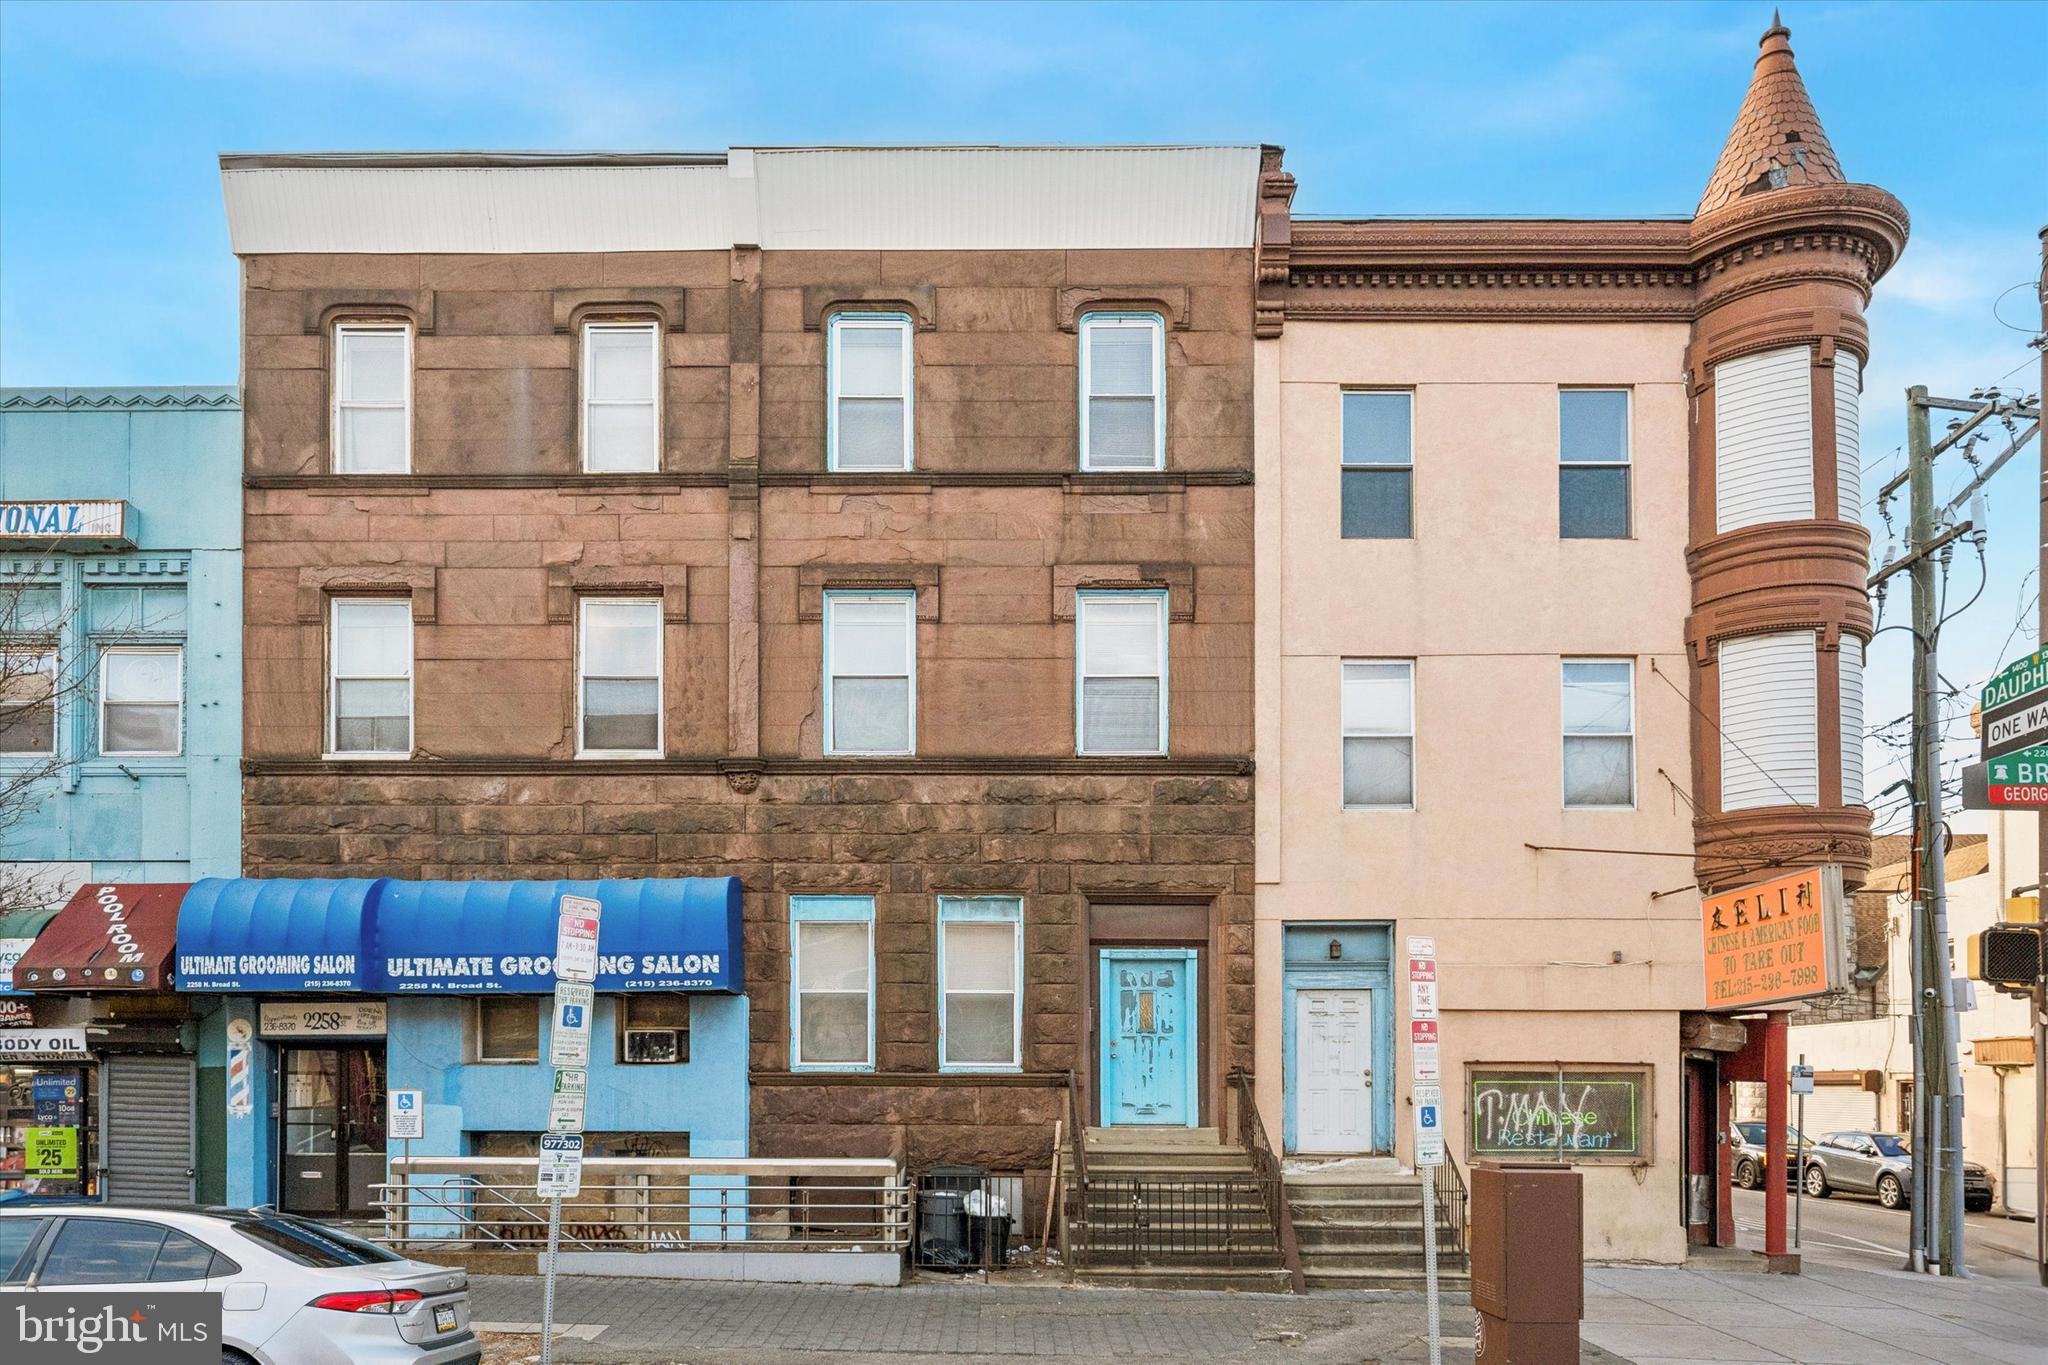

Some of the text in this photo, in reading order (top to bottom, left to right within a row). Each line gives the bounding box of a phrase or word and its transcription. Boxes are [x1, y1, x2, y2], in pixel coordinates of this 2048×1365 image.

[1992, 717, 2021, 741] ONE
[1733, 888, 1789, 927] ELI
[574, 920, 585, 928] NO
[562, 927, 595, 938] STOPPING
[1707, 930, 1740, 955] CHINESE
[1749, 918, 1795, 947] AMERICAN
[1798, 912, 1820, 937] FOOD
[1723, 941, 1805, 975] TO TAKE OUT
[181, 955, 356, 975] ULTIMATE GROOMING SALON
[387, 954, 719, 977] ULTIMATE GRONG SALON
[1411, 971, 1434, 980] STOPPING
[625, 979, 713, 988] (215) 236-8370
[1417, 984, 1429, 993] ANY
[1417, 995, 1430, 1005] TIME
[303, 1011, 340, 1030] 2258
[1413, 1032, 1436, 1041] STOPPING
[49, 1039, 80, 1050] OIL
[568, 1073, 579, 1081] HR
[36, 1078, 77, 1087] Unlimited
[543, 1139, 580, 1149] 977302
